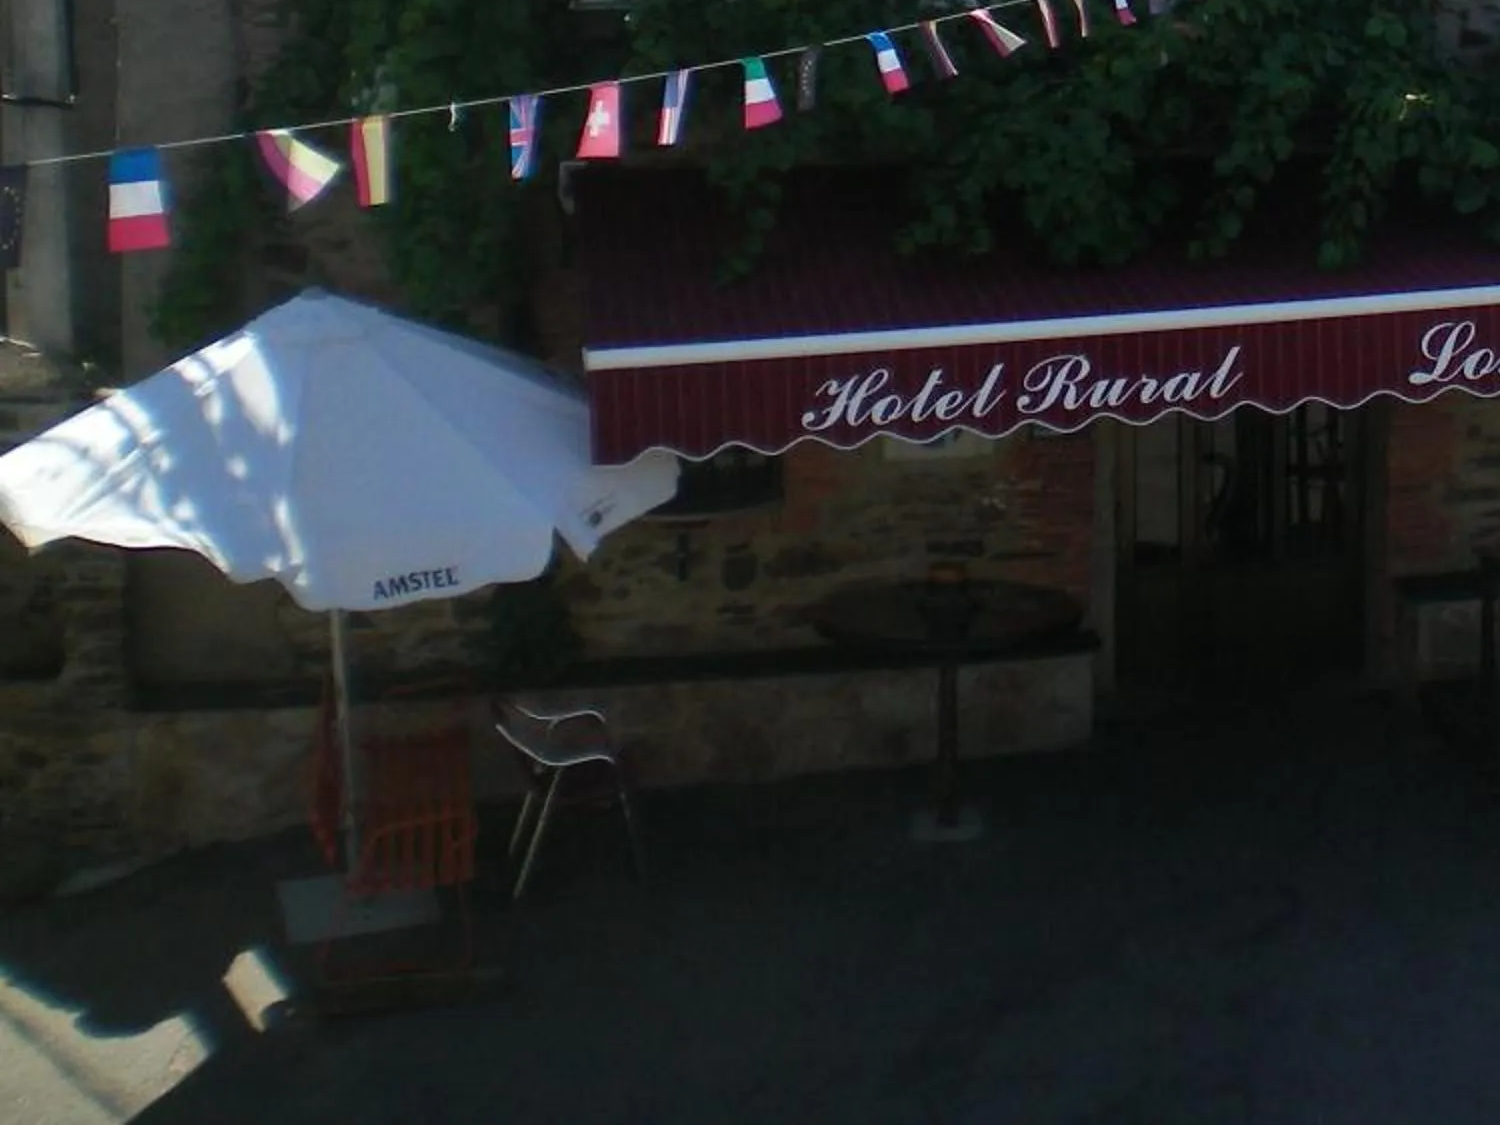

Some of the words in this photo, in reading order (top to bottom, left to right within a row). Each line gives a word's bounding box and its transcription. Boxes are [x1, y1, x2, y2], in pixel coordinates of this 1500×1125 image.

[801, 362, 1006, 432] Hotel
[1016, 346, 1243, 415] Rural
[373, 566, 459, 601] AMSTEL
